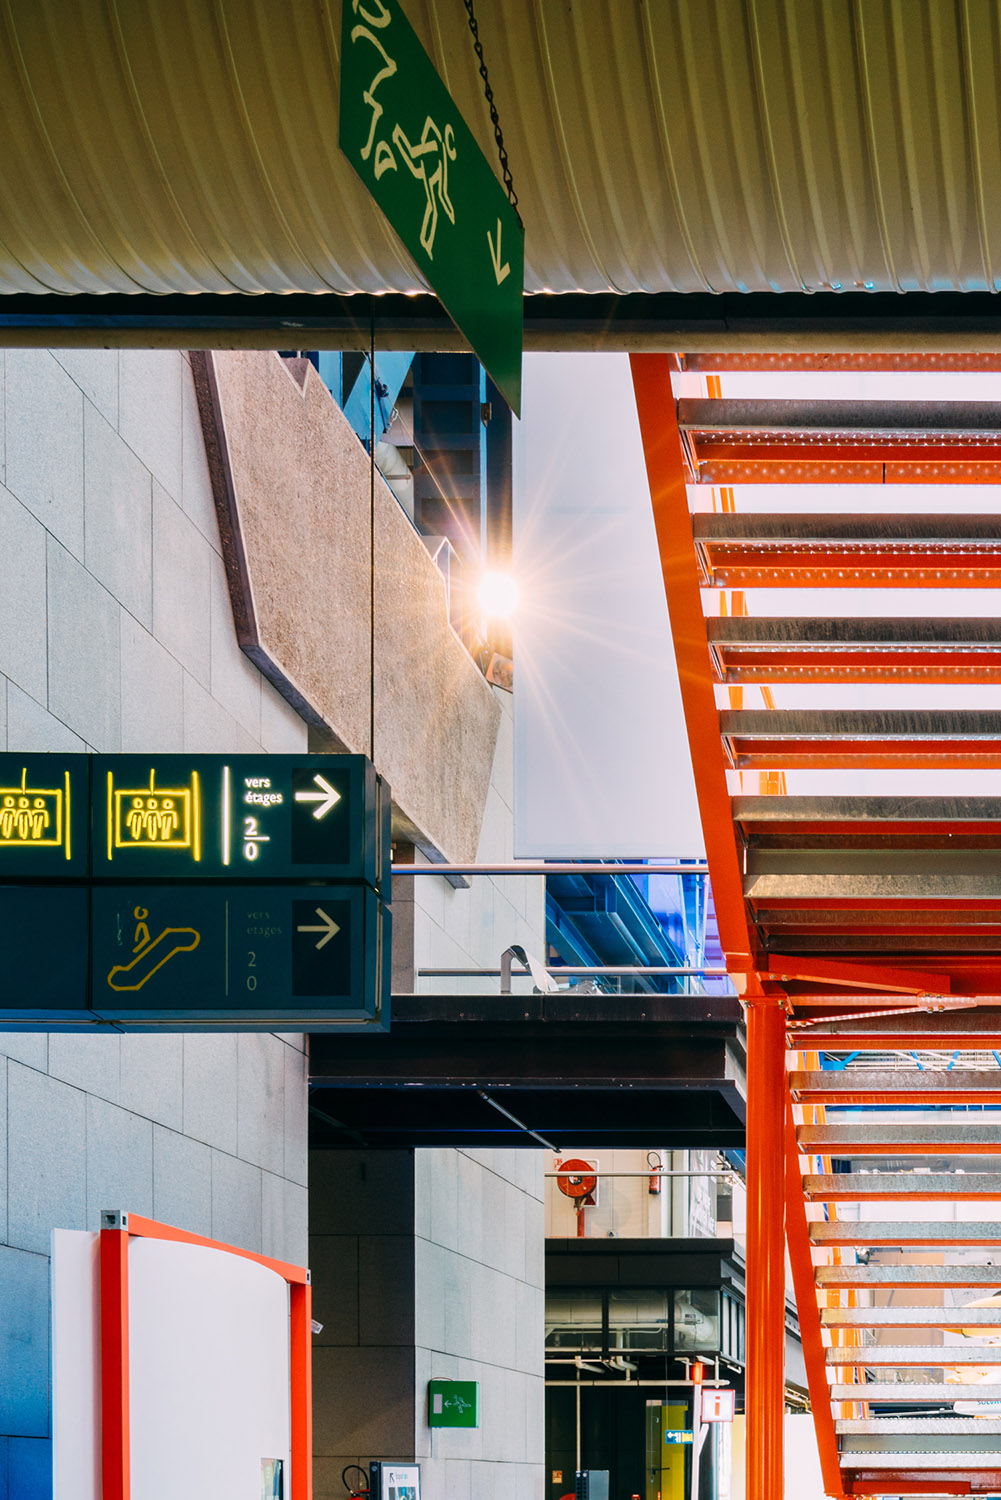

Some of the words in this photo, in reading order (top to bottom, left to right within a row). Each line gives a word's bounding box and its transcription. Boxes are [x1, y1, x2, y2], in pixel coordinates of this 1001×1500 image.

[245, 777, 271, 789] vers
[245, 791, 283, 806] étages
[244, 817, 258, 836] 2
[244, 842, 259, 861] 0
[247, 910, 271, 920] vers
[248, 951, 257, 968] 2
[246, 975, 257, 992] 0
